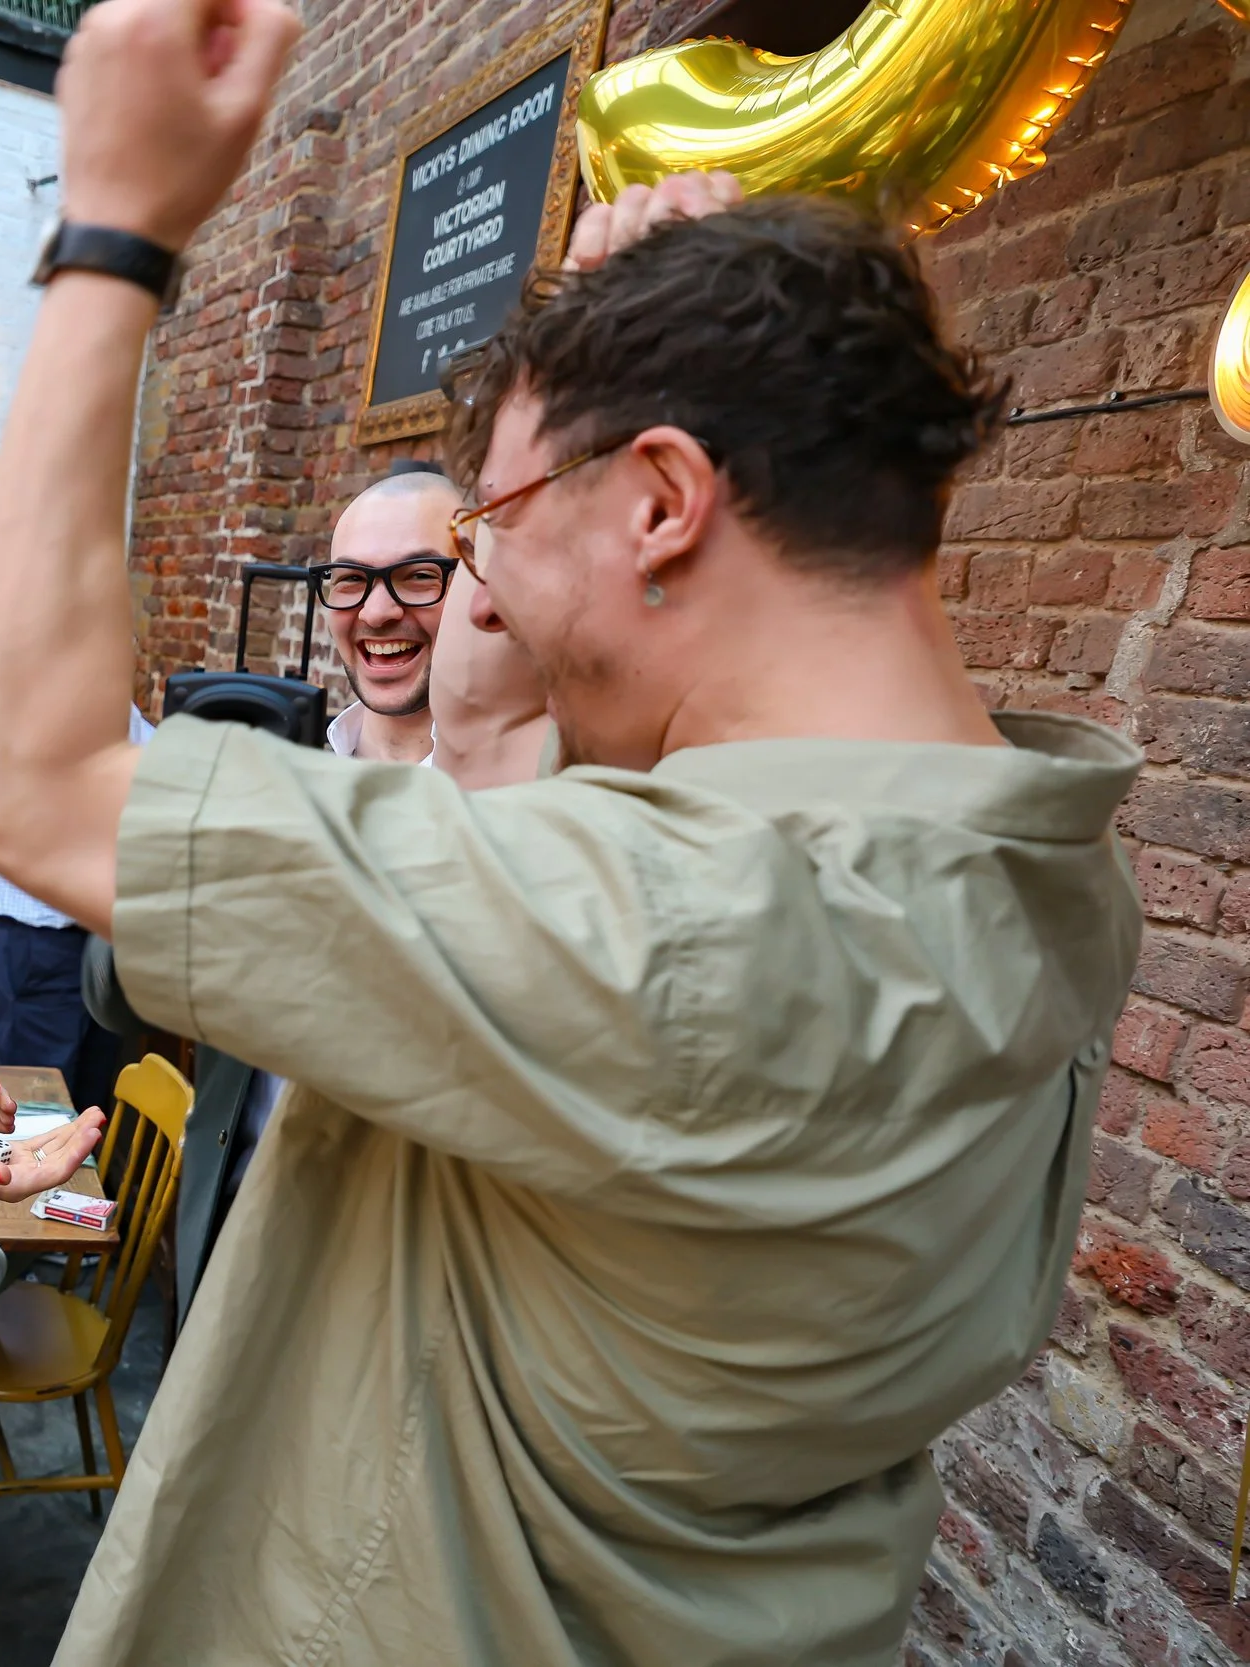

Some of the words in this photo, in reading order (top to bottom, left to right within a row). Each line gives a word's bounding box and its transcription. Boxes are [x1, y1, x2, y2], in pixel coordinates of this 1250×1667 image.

[458, 114, 508, 165] DINING
[508, 82, 555, 134] ROOM
[433, 180, 506, 239] VICTORIAN
[423, 214, 504, 273] COURTYARD
[461, 260, 497, 292] PRIVATE
